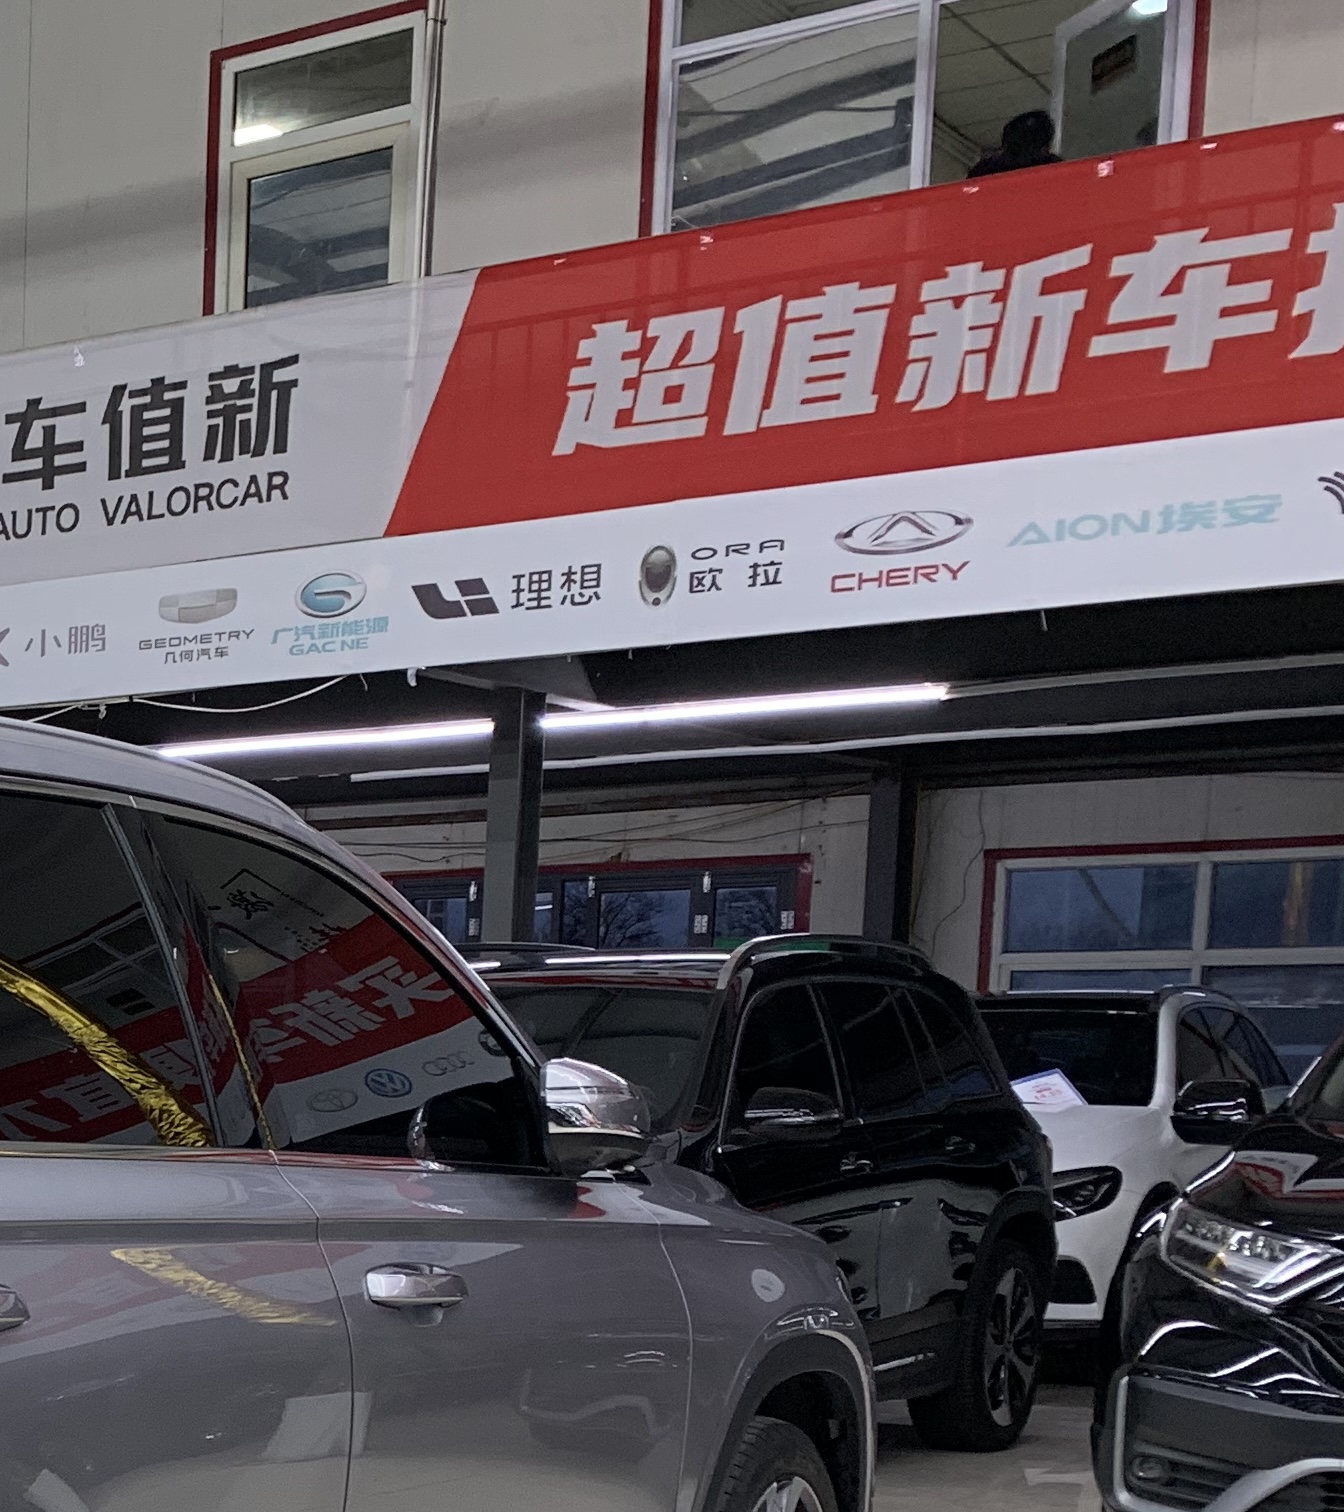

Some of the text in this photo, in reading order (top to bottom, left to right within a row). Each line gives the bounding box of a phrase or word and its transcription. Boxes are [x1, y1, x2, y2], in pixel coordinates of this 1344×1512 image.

[99, 469, 290, 526] VALORCAR
[689, 538, 786, 560] ORA
[511, 563, 603, 612] 理想
[688, 559, 783, 595] 欧拉
[830, 560, 970, 594] CHERY
[24, 623, 107, 658] 小鹏
[138, 628, 255, 651] GEOMETRY
[271, 616, 389, 646] 广汽新能源
[289, 637, 369, 657] GAC NE
[163, 646, 229, 664] 几何汽车
